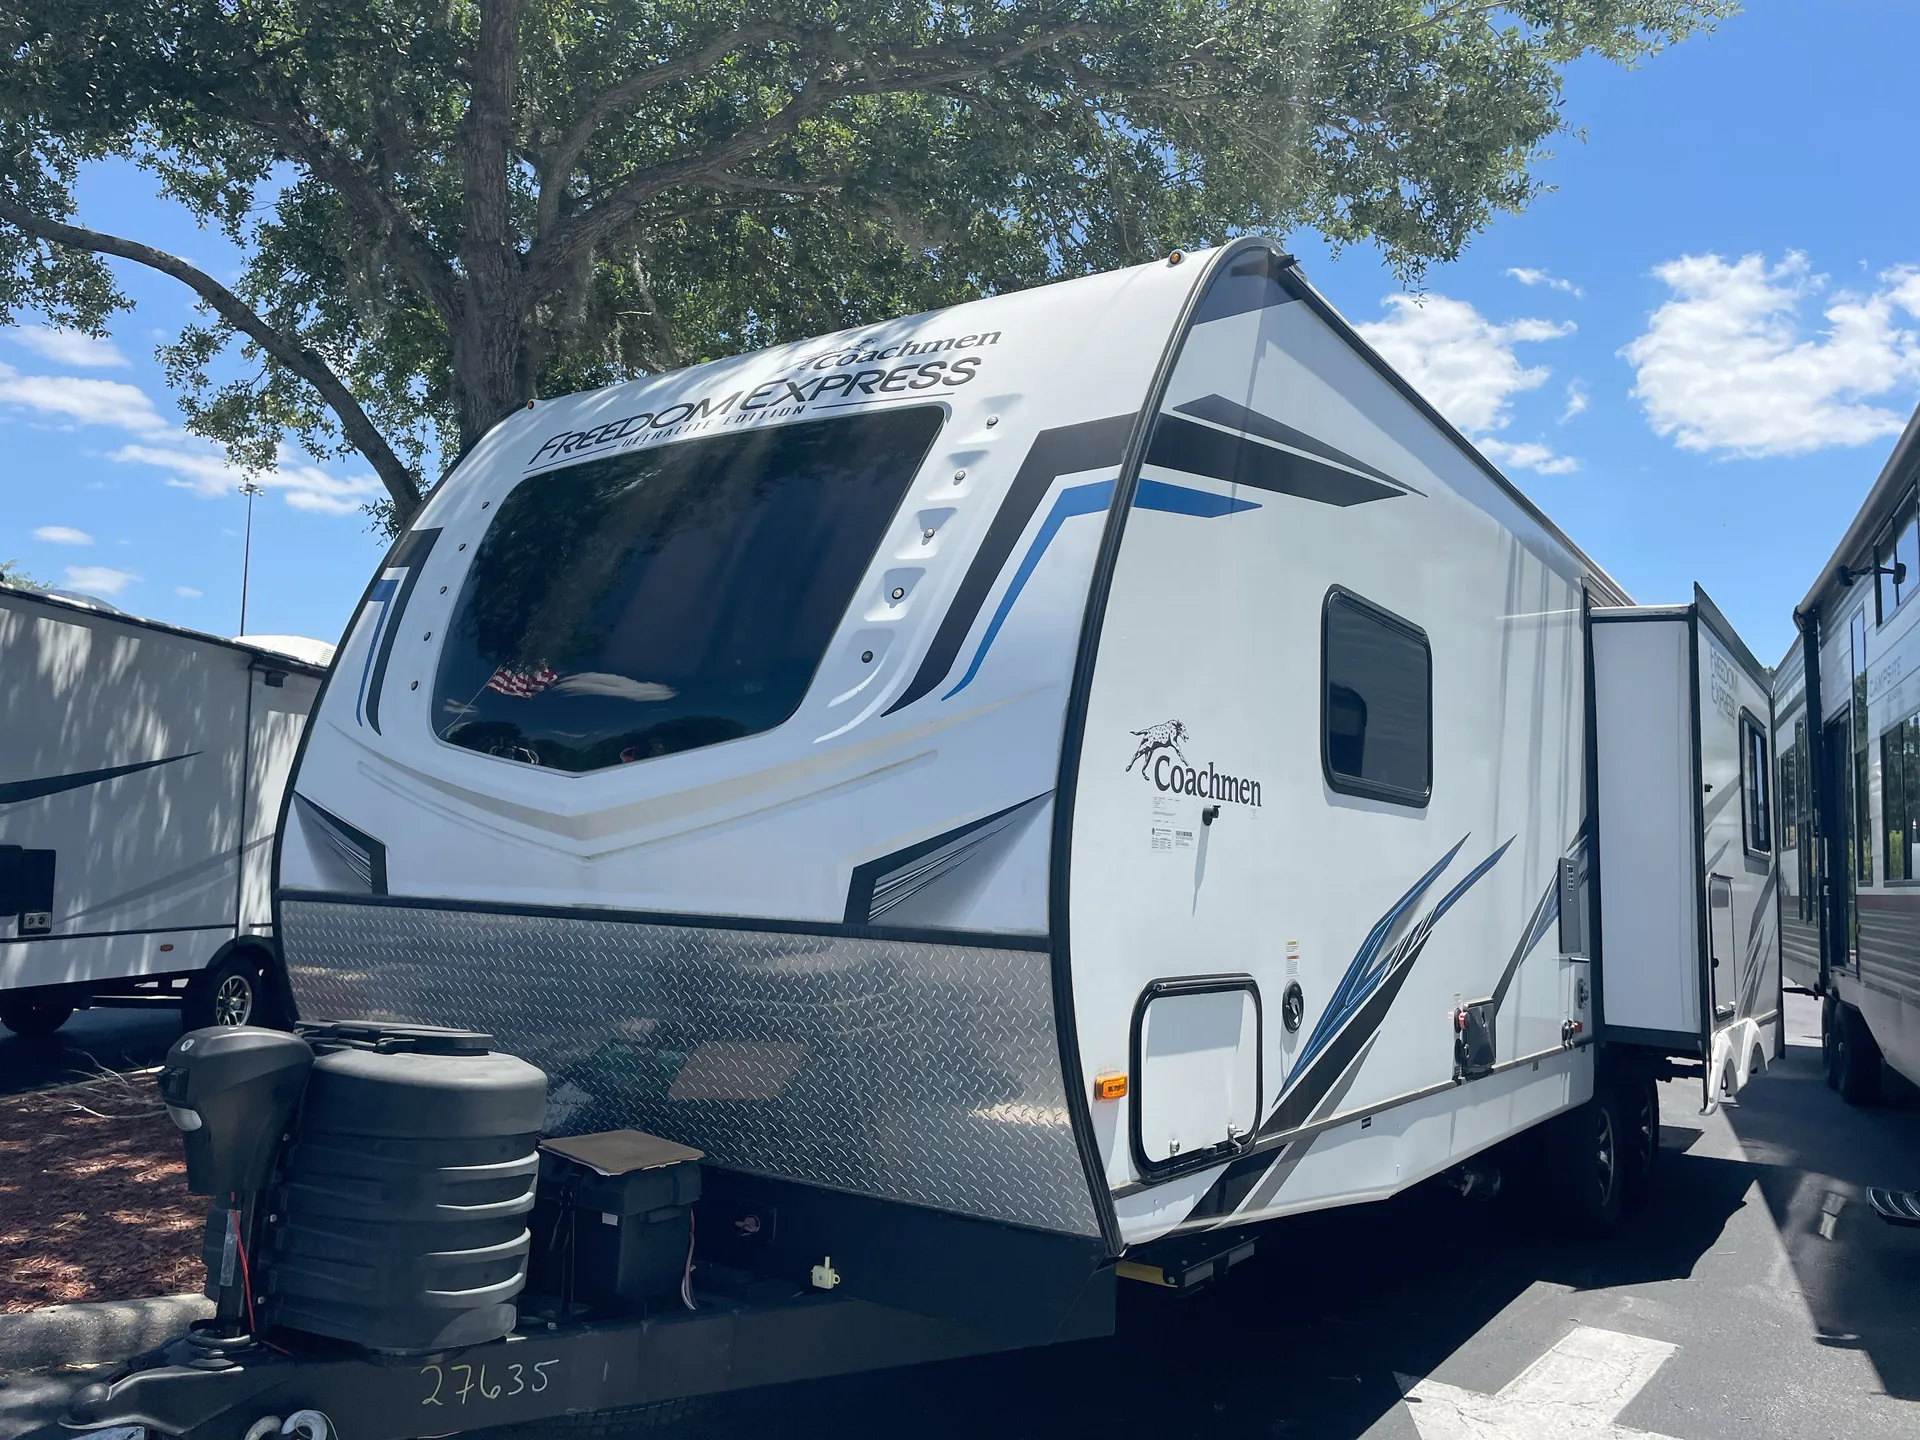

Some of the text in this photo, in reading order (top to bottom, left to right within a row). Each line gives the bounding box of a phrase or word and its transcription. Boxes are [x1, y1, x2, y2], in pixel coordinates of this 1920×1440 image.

[813, 331, 1001, 371] Coachmen
[528, 357, 981, 465] FREEDOM EXPRESS
[723, 405, 806, 426] EDITION
[1154, 755, 1262, 807] Coachmen
[420, 1359, 560, 1405] 27635
